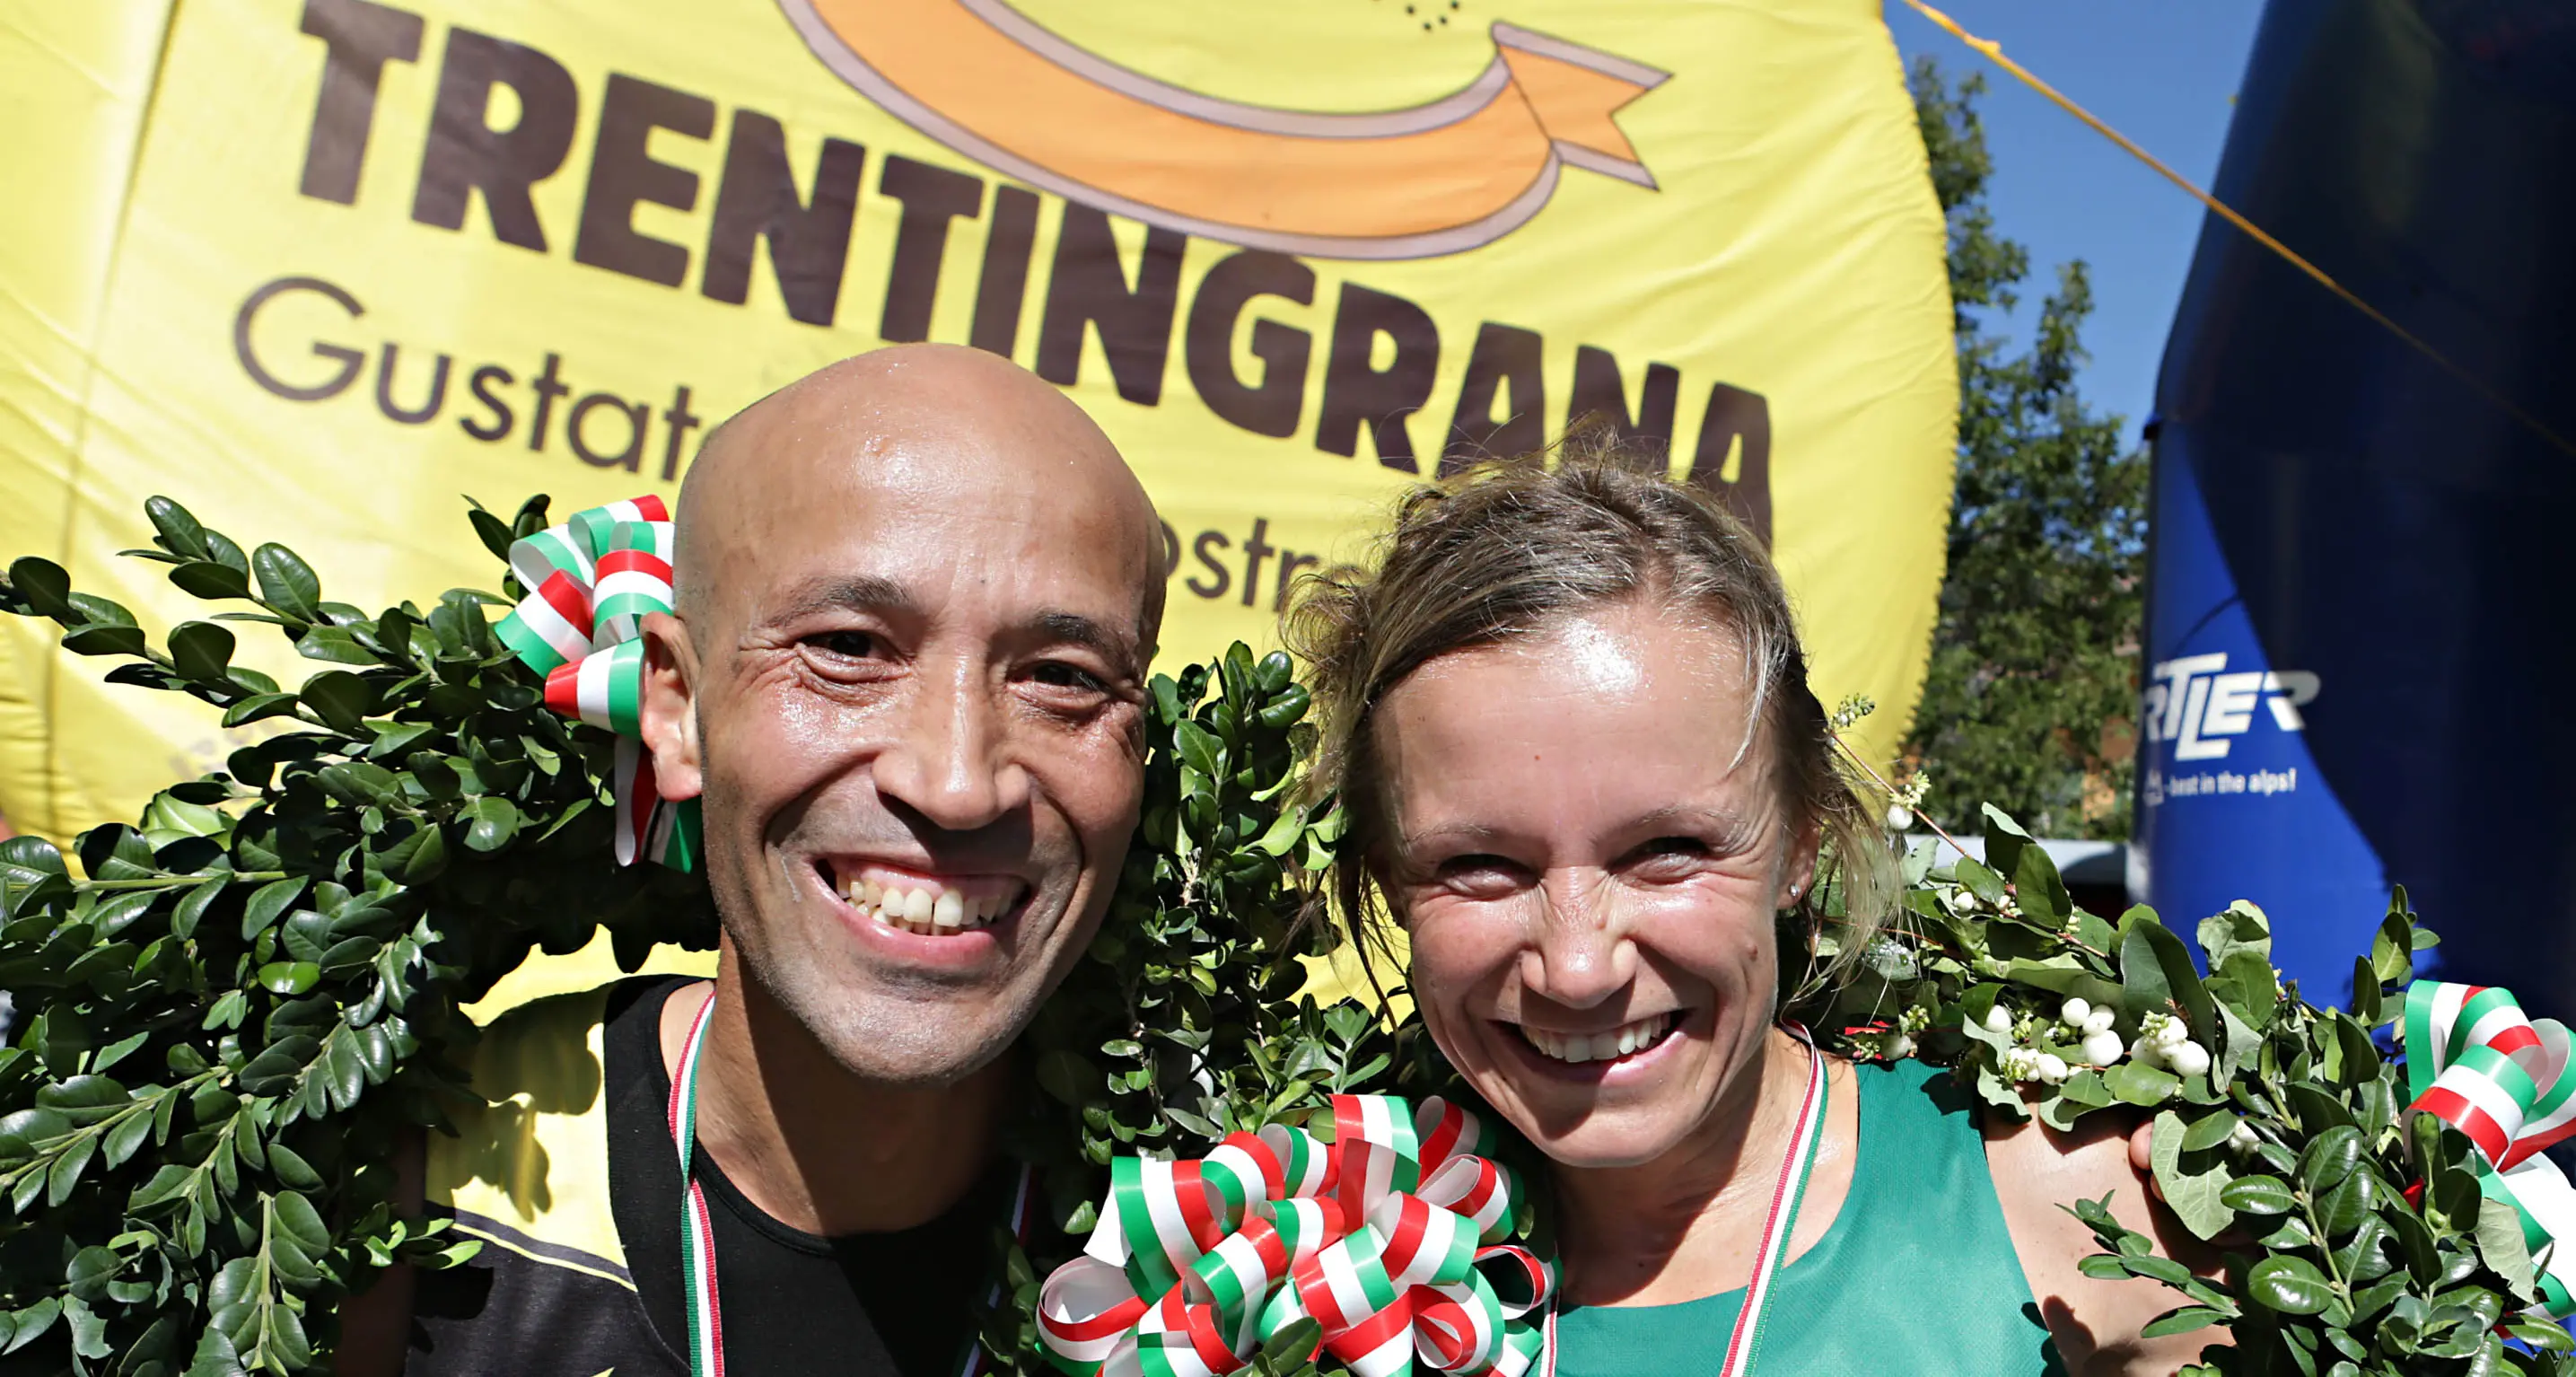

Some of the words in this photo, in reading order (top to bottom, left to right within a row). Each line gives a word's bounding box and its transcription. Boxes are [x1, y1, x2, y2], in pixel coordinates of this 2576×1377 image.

[232, 276, 721, 482] Gustat
[299, 0, 1774, 558] TRENTINGRANA
[2200, 772, 2215, 794] in
[2217, 770, 2246, 794] the
[2248, 767, 2297, 796] alps!
